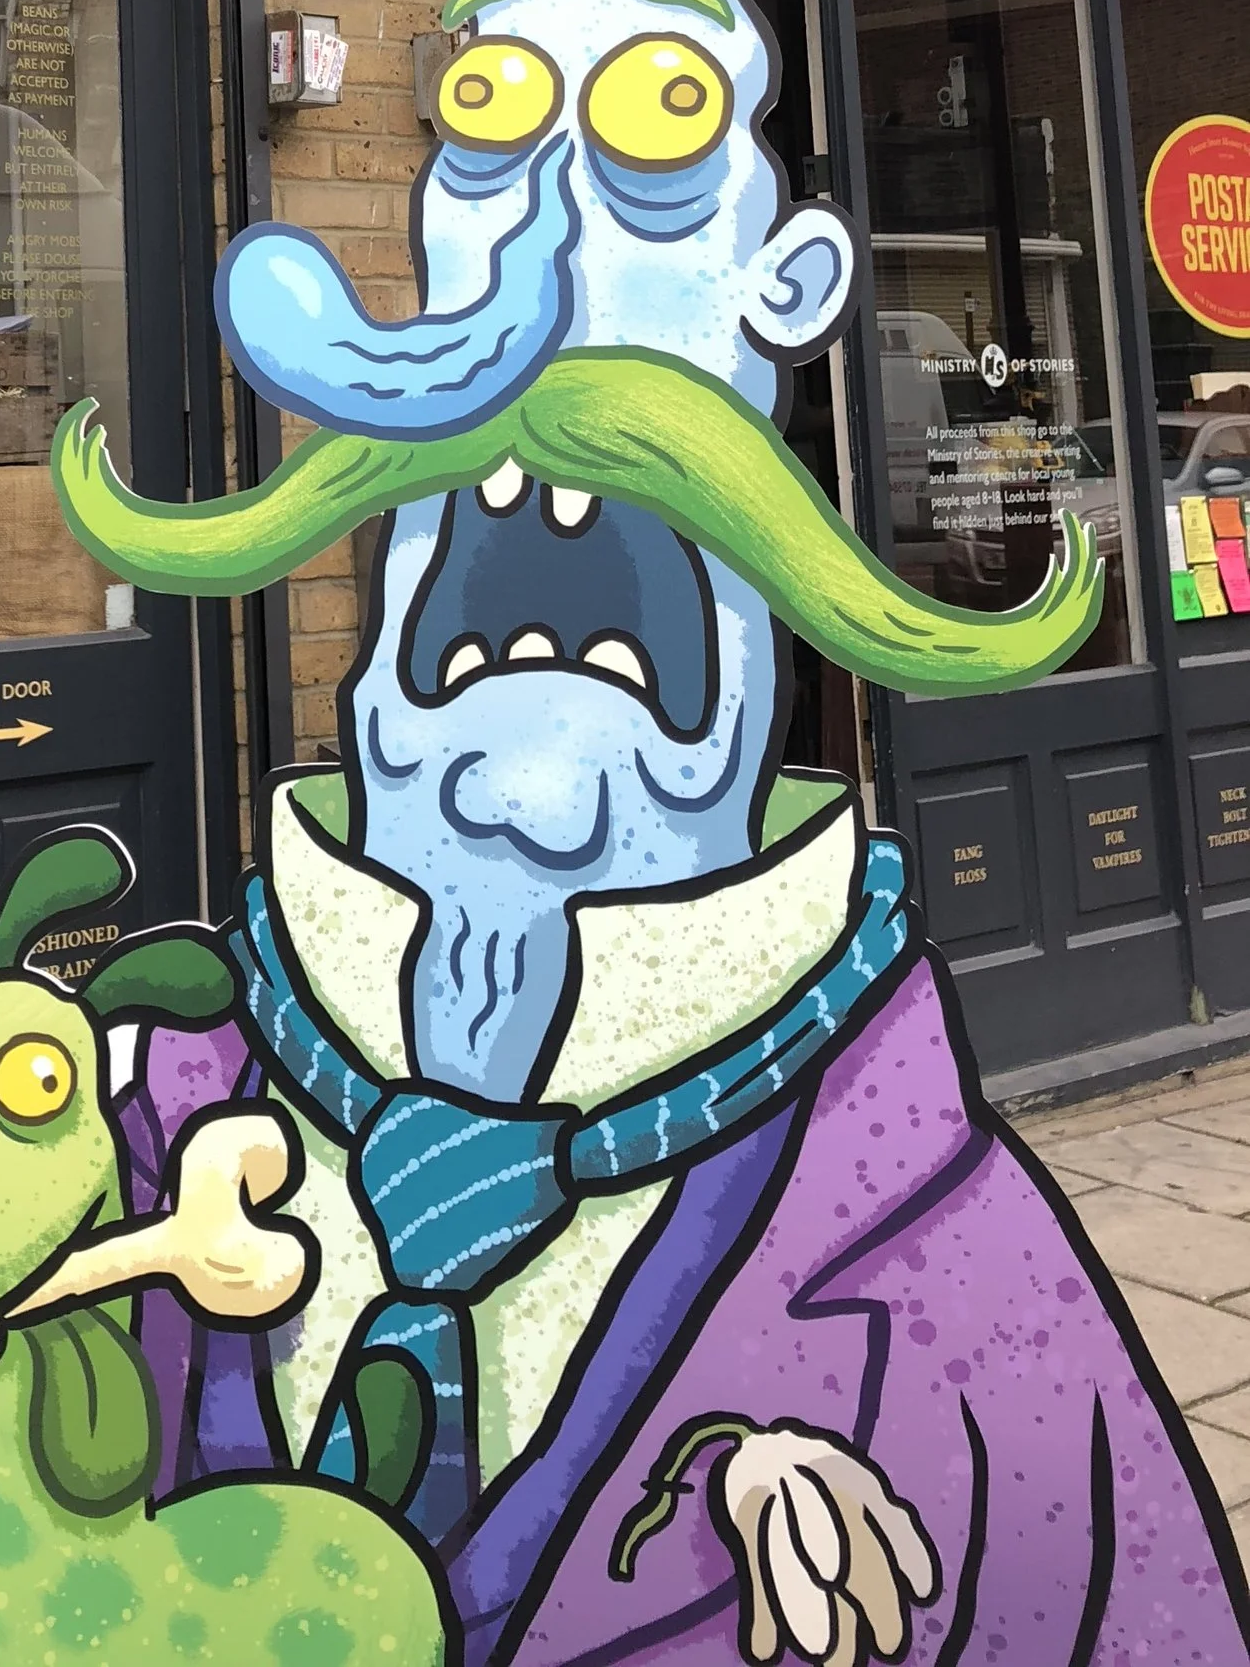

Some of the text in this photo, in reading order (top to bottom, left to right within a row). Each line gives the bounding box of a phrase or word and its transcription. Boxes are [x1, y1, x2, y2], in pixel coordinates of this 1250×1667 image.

[22, 5, 58, 19] BEANS
[10, 22, 70, 37] (MAGIC OR
[6, 39, 75, 56] OTHERWISE)
[16, 57, 66, 72] ARE NOT
[10, 75, 69, 90] ACCEPTED
[8, 92, 76, 107] AS PAYMENT
[18, 128, 68, 142] HUMANS
[20, 181, 68, 194] AT THEIR
[50, 200, 72, 212] RISK
[1181, 223, 1250, 273] SERVI
[35, 271, 84, 283] TORCHE
[44, 307, 74, 319] SHOP
[921, 359, 976, 373] MINISTRY
[1011, 359, 1027, 373] OF
[1029, 358, 1075, 372] STORIES
[926, 423, 1073, 443] All proceeds from this shop go to the
[927, 449, 961, 464] Ministry
[963, 446, 973, 460] of
[1006, 446, 1020, 459] the
[929, 471, 945, 485] and
[946, 471, 989, 486] mentoring
[1018, 467, 1031, 481] for
[1031, 467, 1050, 482] local
[1050, 468, 1076, 483] young
[931, 493, 960, 511] people
[961, 491, 981, 509] aged
[1004, 490, 1026, 504] Look
[1026, 488, 1045, 503] hard
[1046, 487, 1061, 501] and
[932, 516, 949, 531] find
[950, 516, 958, 529] it
[958, 513, 987, 530] hidden
[988, 513, 1004, 530] just
[1004, 511, 1032, 526] behind
[1033, 512, 1048, 524] our
[1, 680, 53, 700] DOOR
[1088, 805, 1139, 827] DAYLIGHT
[1104, 830, 1127, 846] FOR
[954, 844, 983, 863] FANG
[1092, 848, 1143, 871] VAMPIRES
[954, 867, 988, 886] FLOSS
[31, 924, 120, 954] SHIONED
